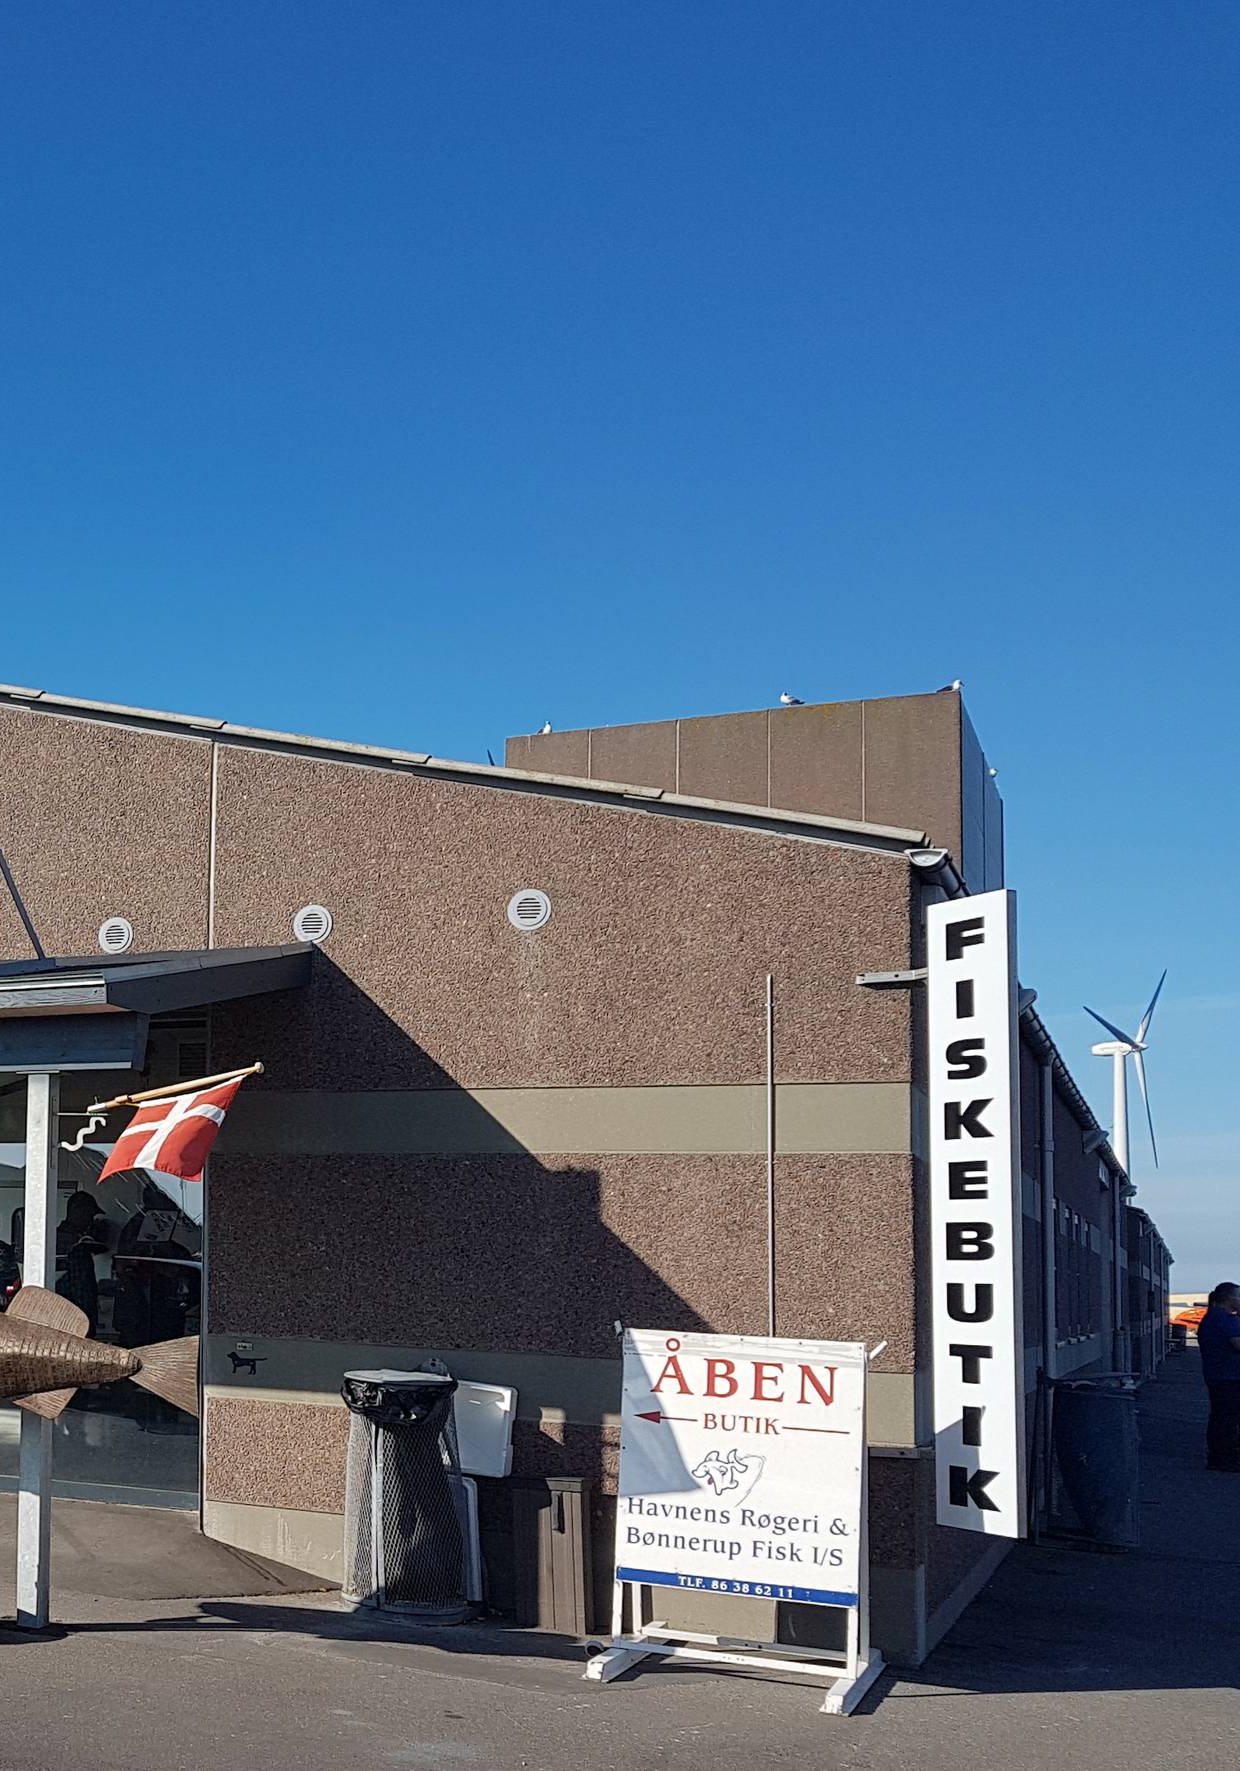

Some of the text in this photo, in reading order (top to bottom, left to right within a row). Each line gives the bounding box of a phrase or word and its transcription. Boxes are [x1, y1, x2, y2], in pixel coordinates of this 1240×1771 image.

[943, 916, 1001, 1513] FISKEBUTIK
[650, 1338, 839, 1407] ÅBEN
[703, 1413, 780, 1436] BUTIK
[627, 1497, 849, 1537] Havnens Røgeri &
[626, 1527, 742, 1560] Bønnerup
[752, 1541, 803, 1562] Fisk
[678, 1576, 793, 1599] TLF. 86 38 62 11
